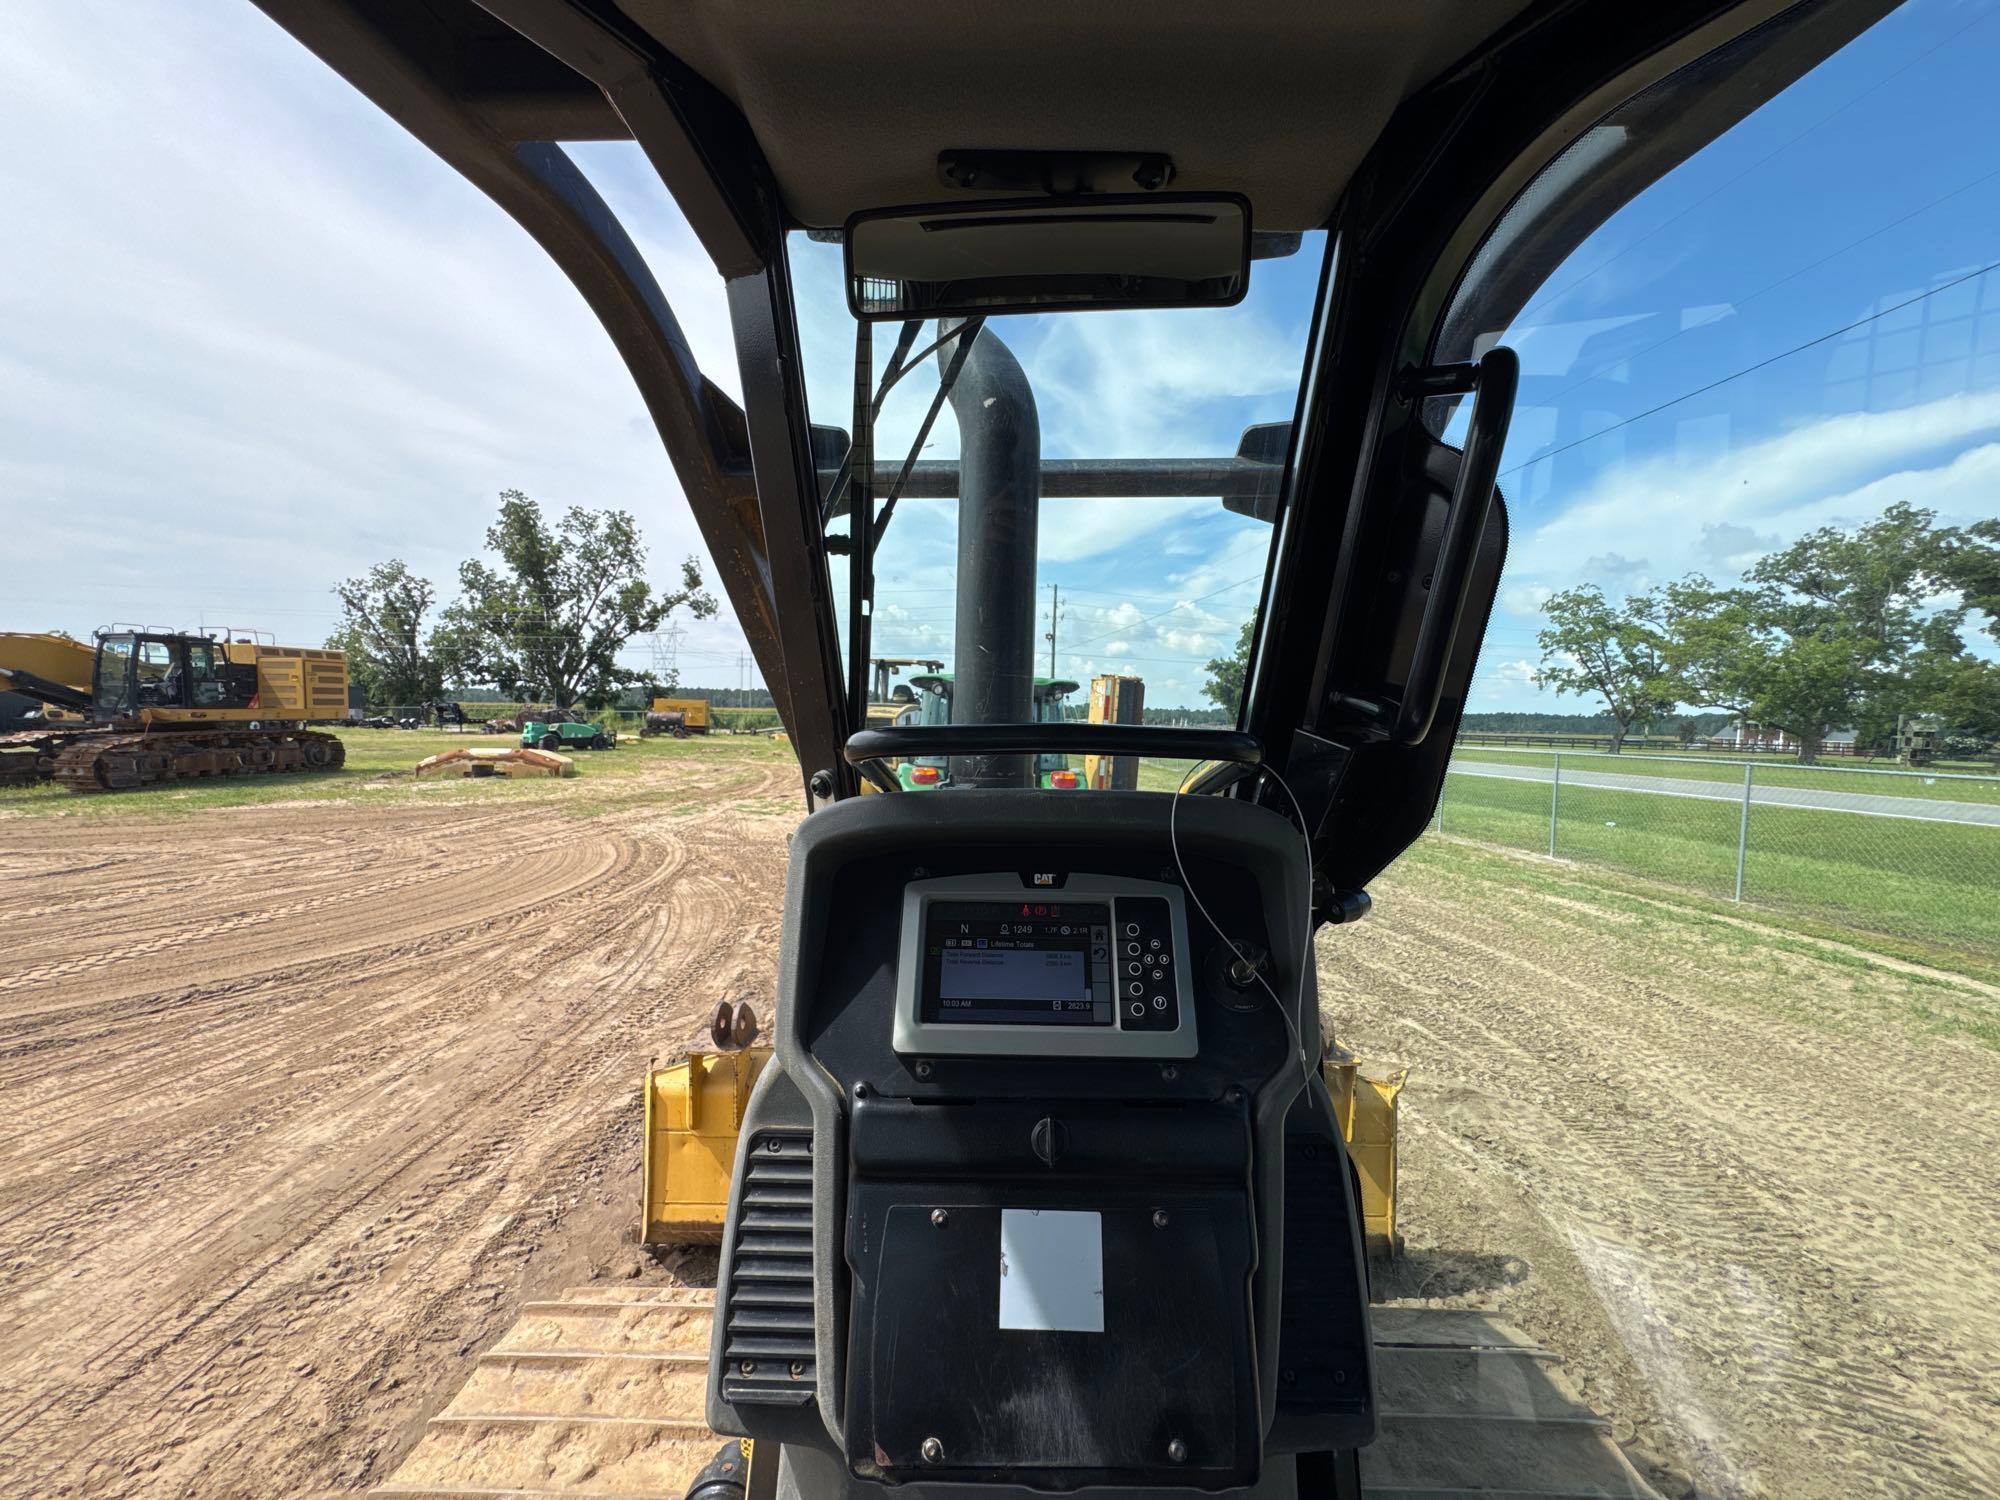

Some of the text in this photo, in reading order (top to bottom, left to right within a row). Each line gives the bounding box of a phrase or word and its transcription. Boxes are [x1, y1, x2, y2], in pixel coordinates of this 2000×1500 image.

[1034, 873, 1053, 885] CAT
[961, 923, 969, 934] N
[1013, 925, 1033, 934] 1249
[1068, 1002, 1090, 1010] 2823.9
